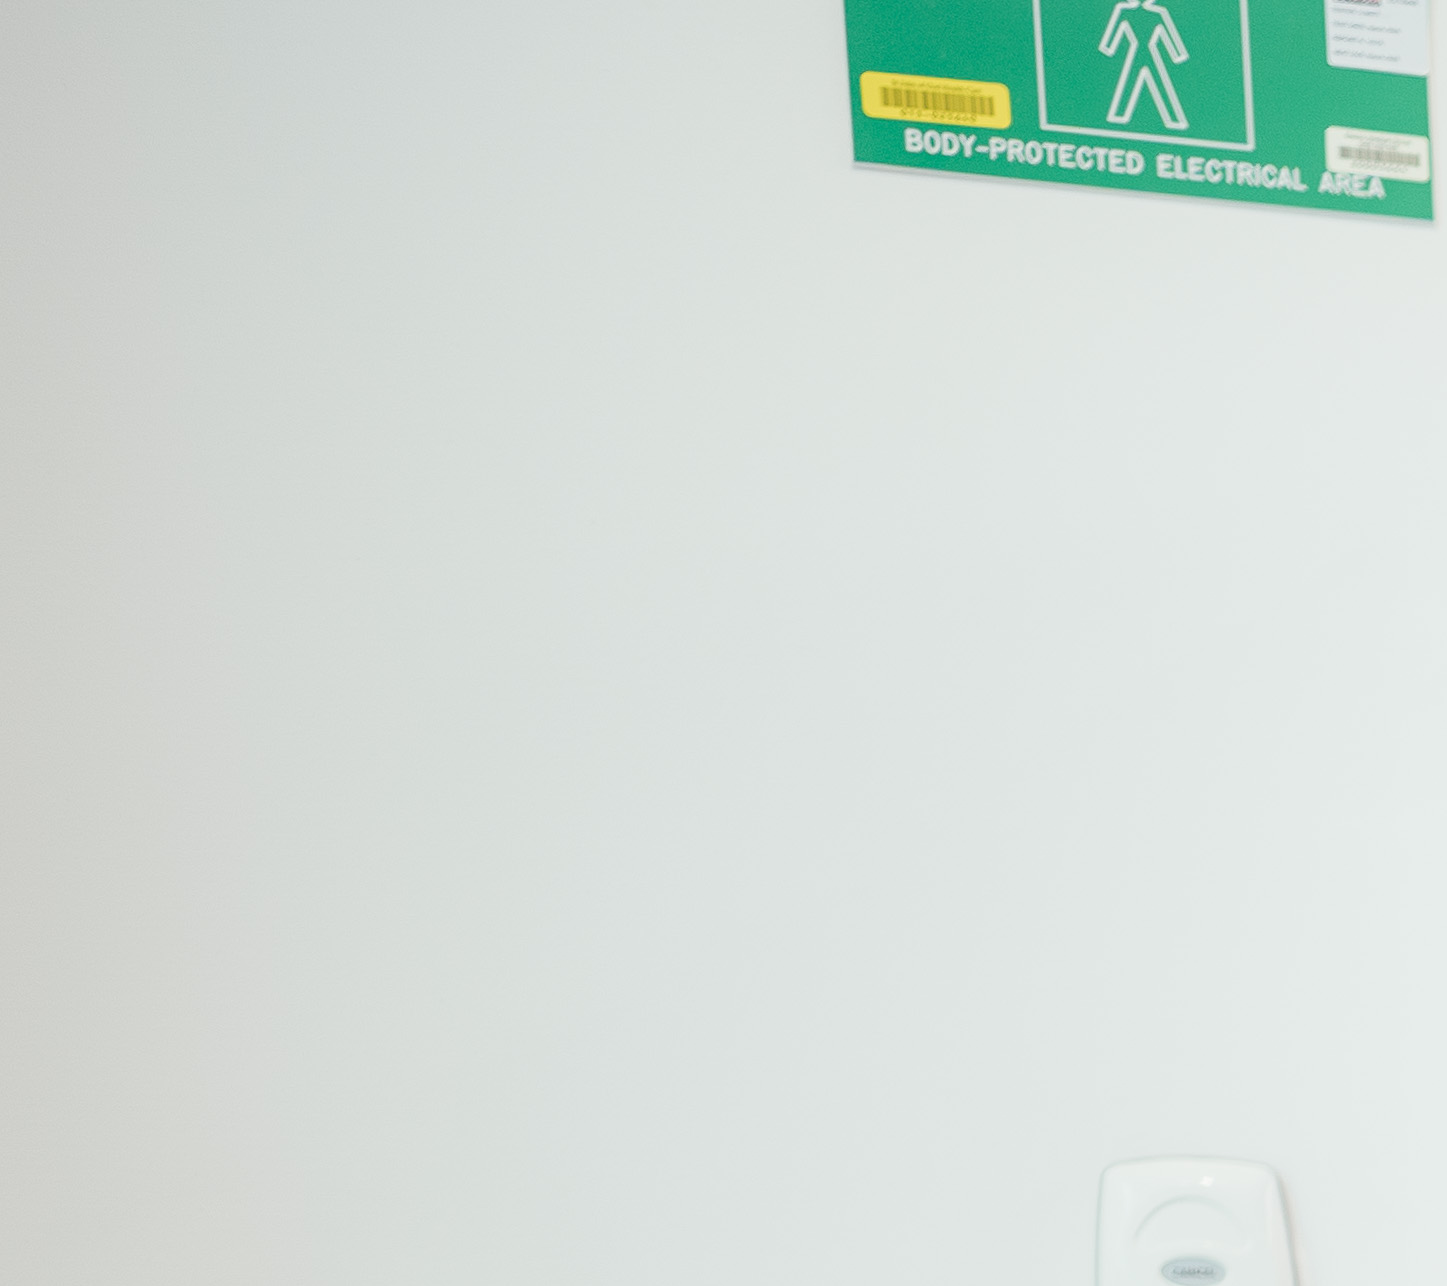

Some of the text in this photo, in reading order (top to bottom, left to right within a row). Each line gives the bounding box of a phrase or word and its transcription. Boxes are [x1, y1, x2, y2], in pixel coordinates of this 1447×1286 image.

[904, 127, 1387, 199] BODY-PROTECTED ELECTRICAL AREA
